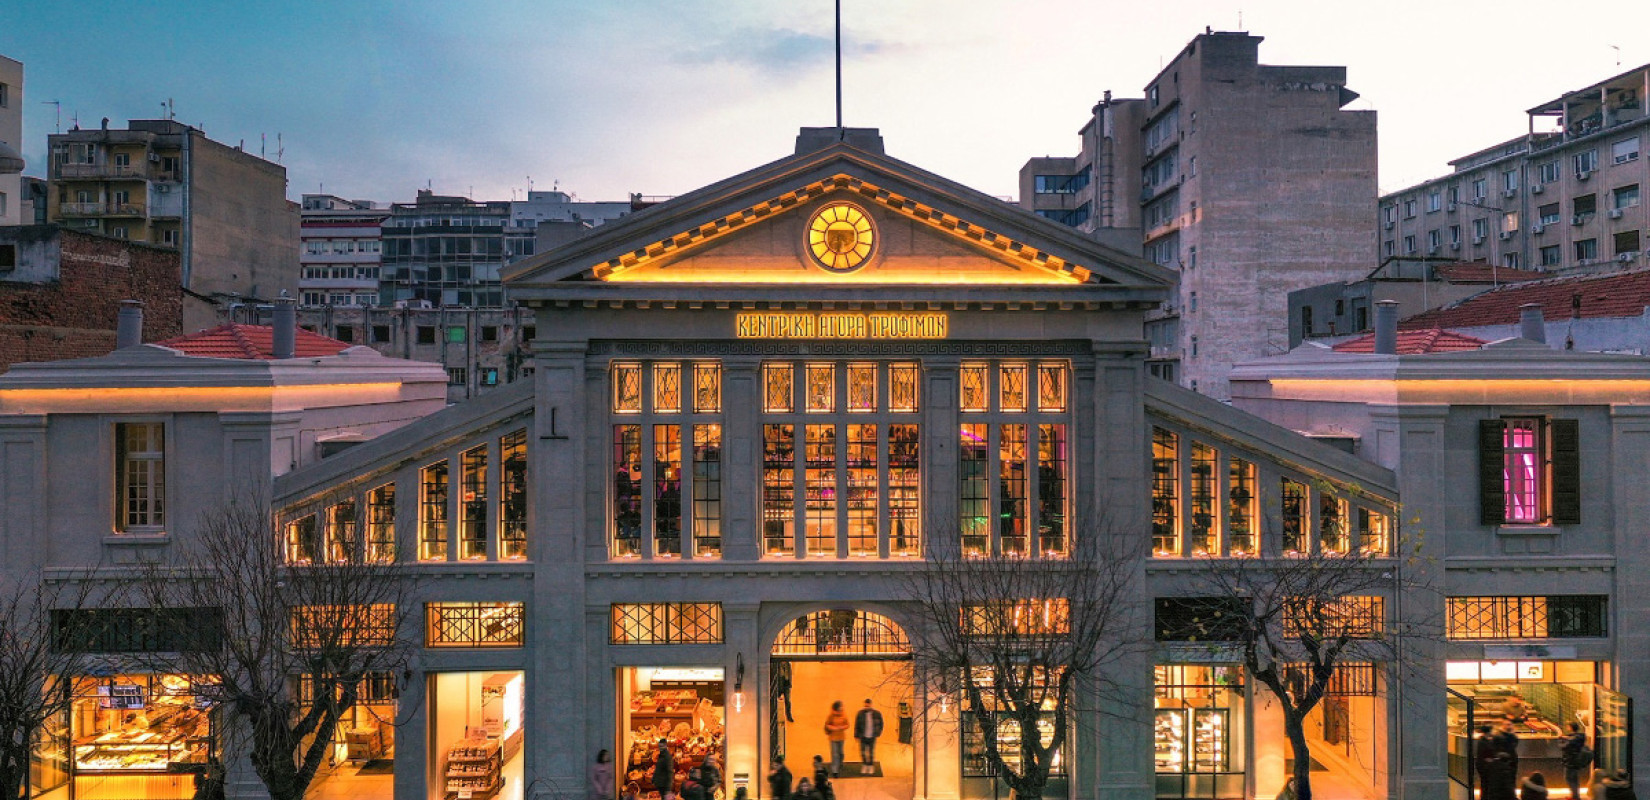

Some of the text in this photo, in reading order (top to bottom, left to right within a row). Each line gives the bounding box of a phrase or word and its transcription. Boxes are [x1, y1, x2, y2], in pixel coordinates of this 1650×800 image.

[738, 314, 946, 337] ΚΕΝΤΡΙΚΗ ΑΓΟΡΑ ΤΡΟΦΙΜΩΝ
